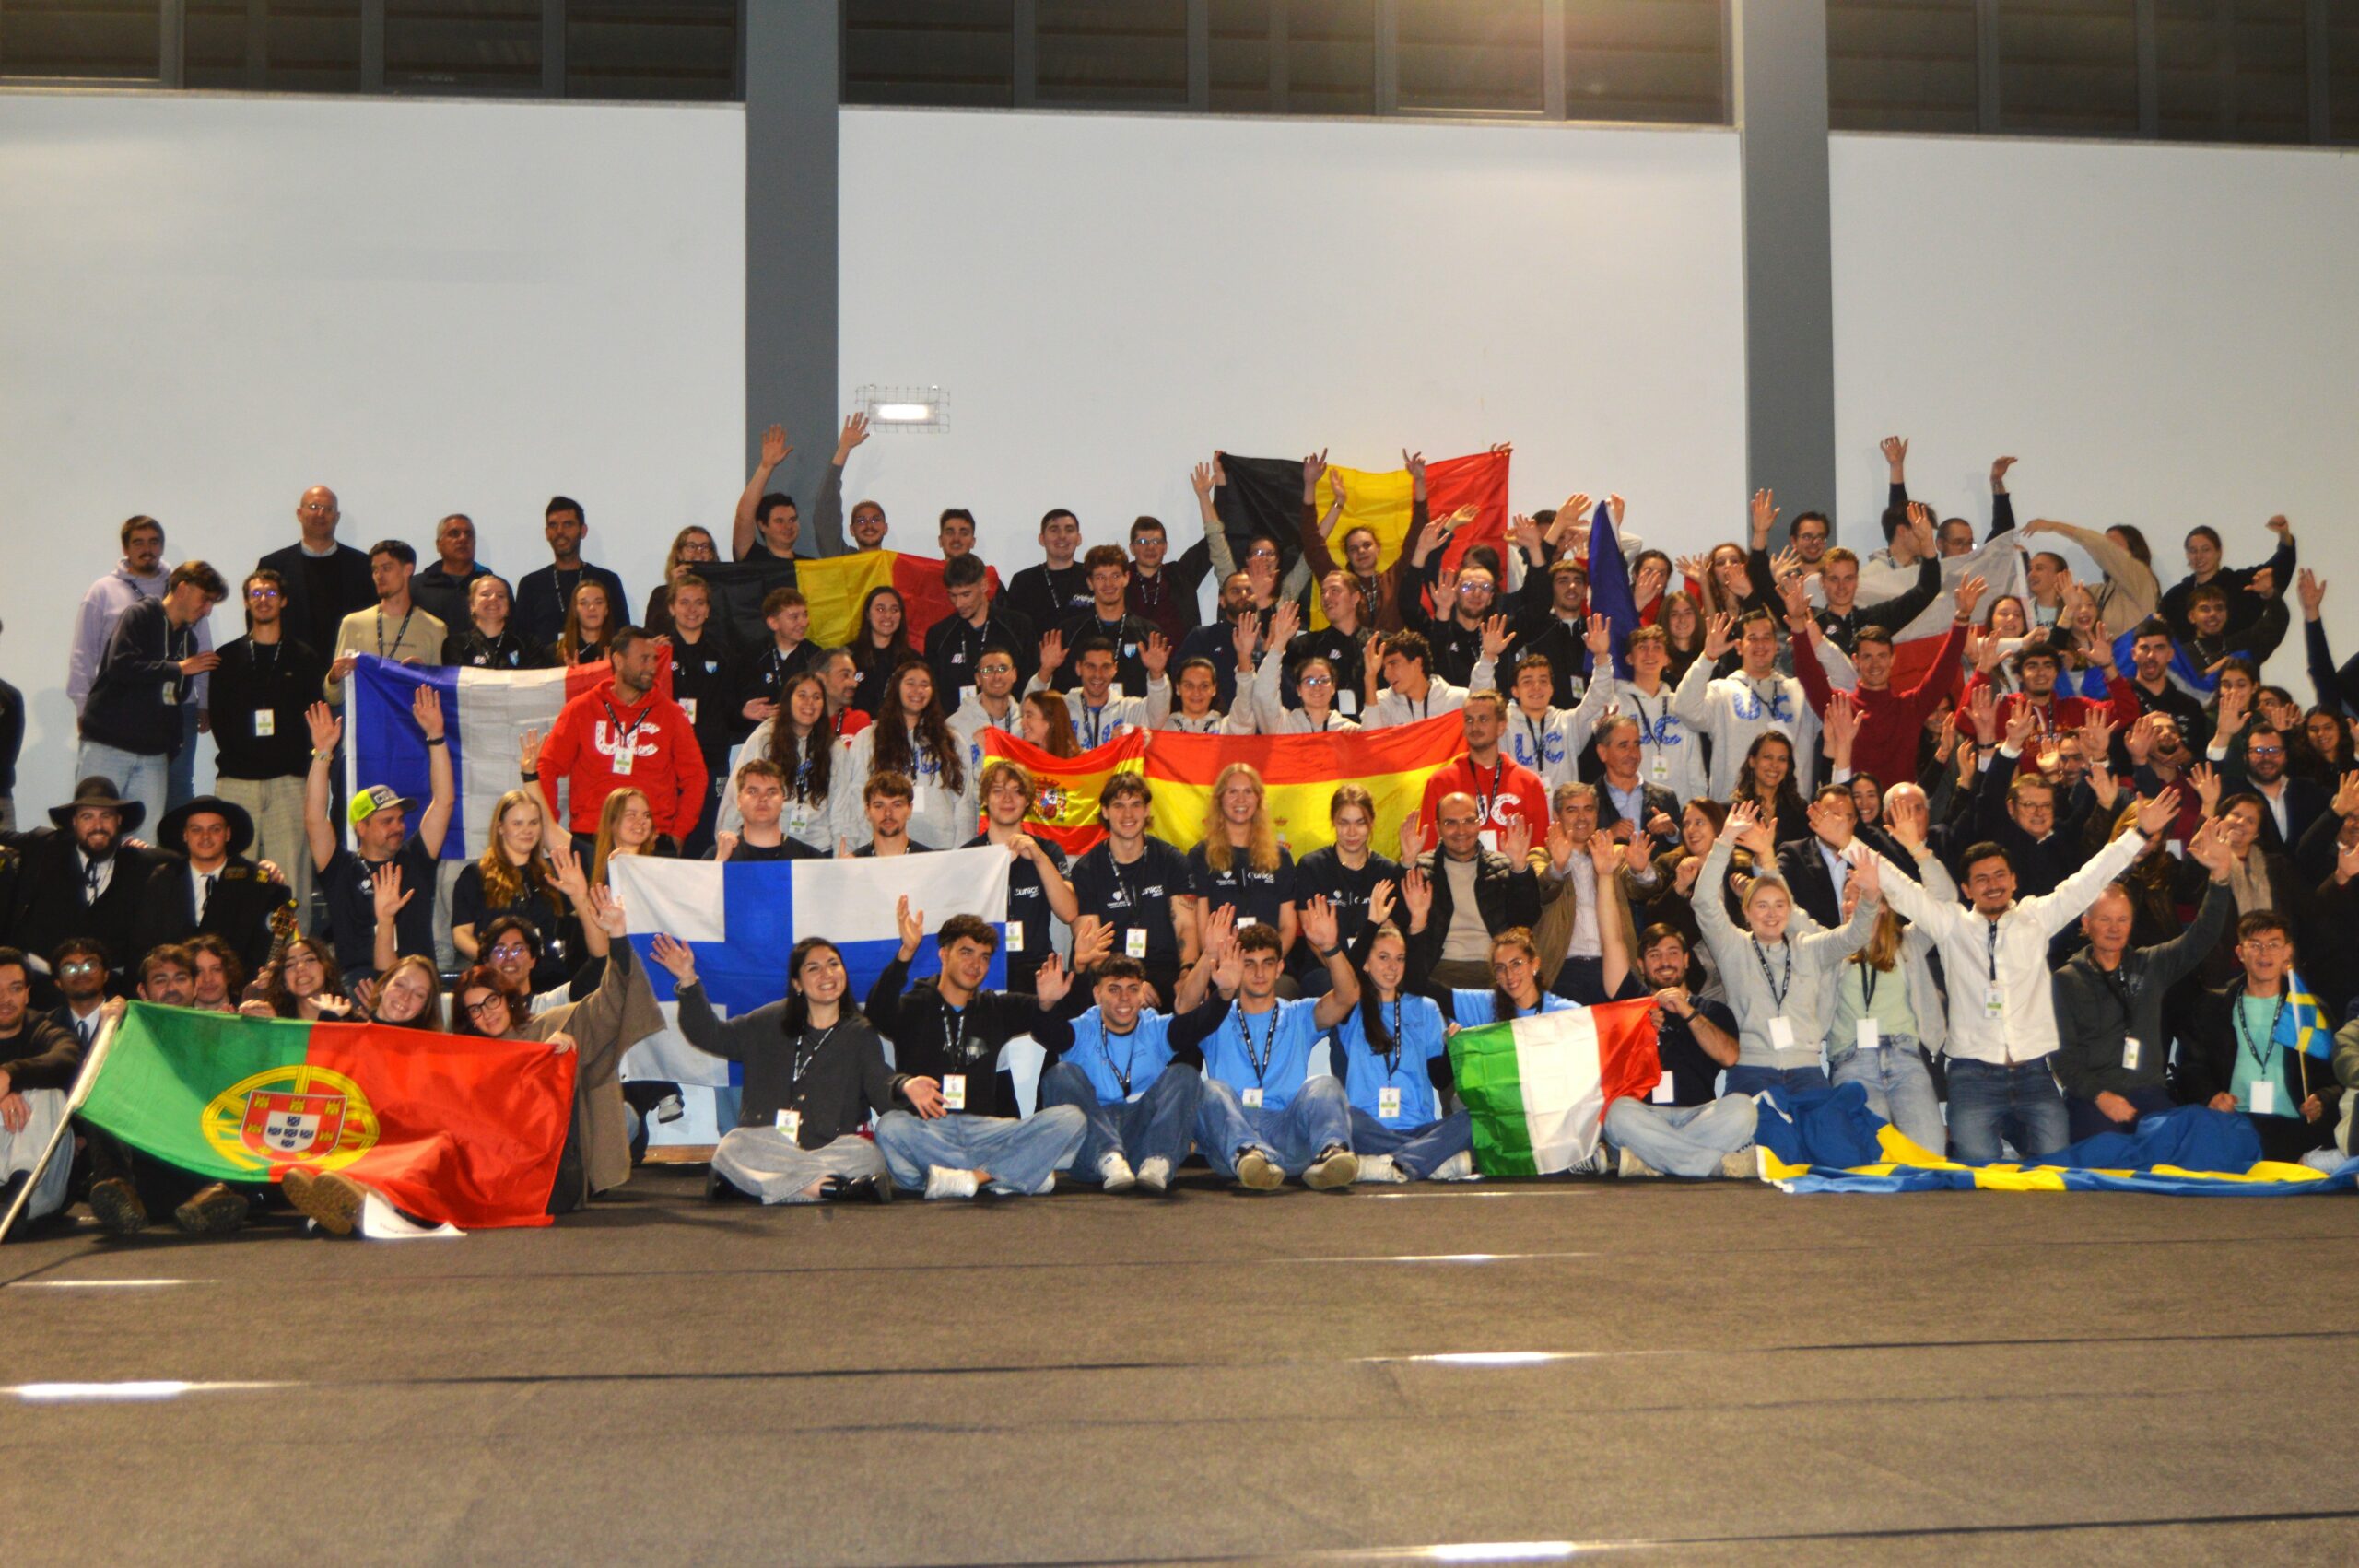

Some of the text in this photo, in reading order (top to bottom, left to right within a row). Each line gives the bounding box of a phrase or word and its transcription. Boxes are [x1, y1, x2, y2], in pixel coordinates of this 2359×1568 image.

[1733, 692, 1794, 723] UC
[595, 720, 661, 757] UC
[1515, 731, 1565, 766] UC
